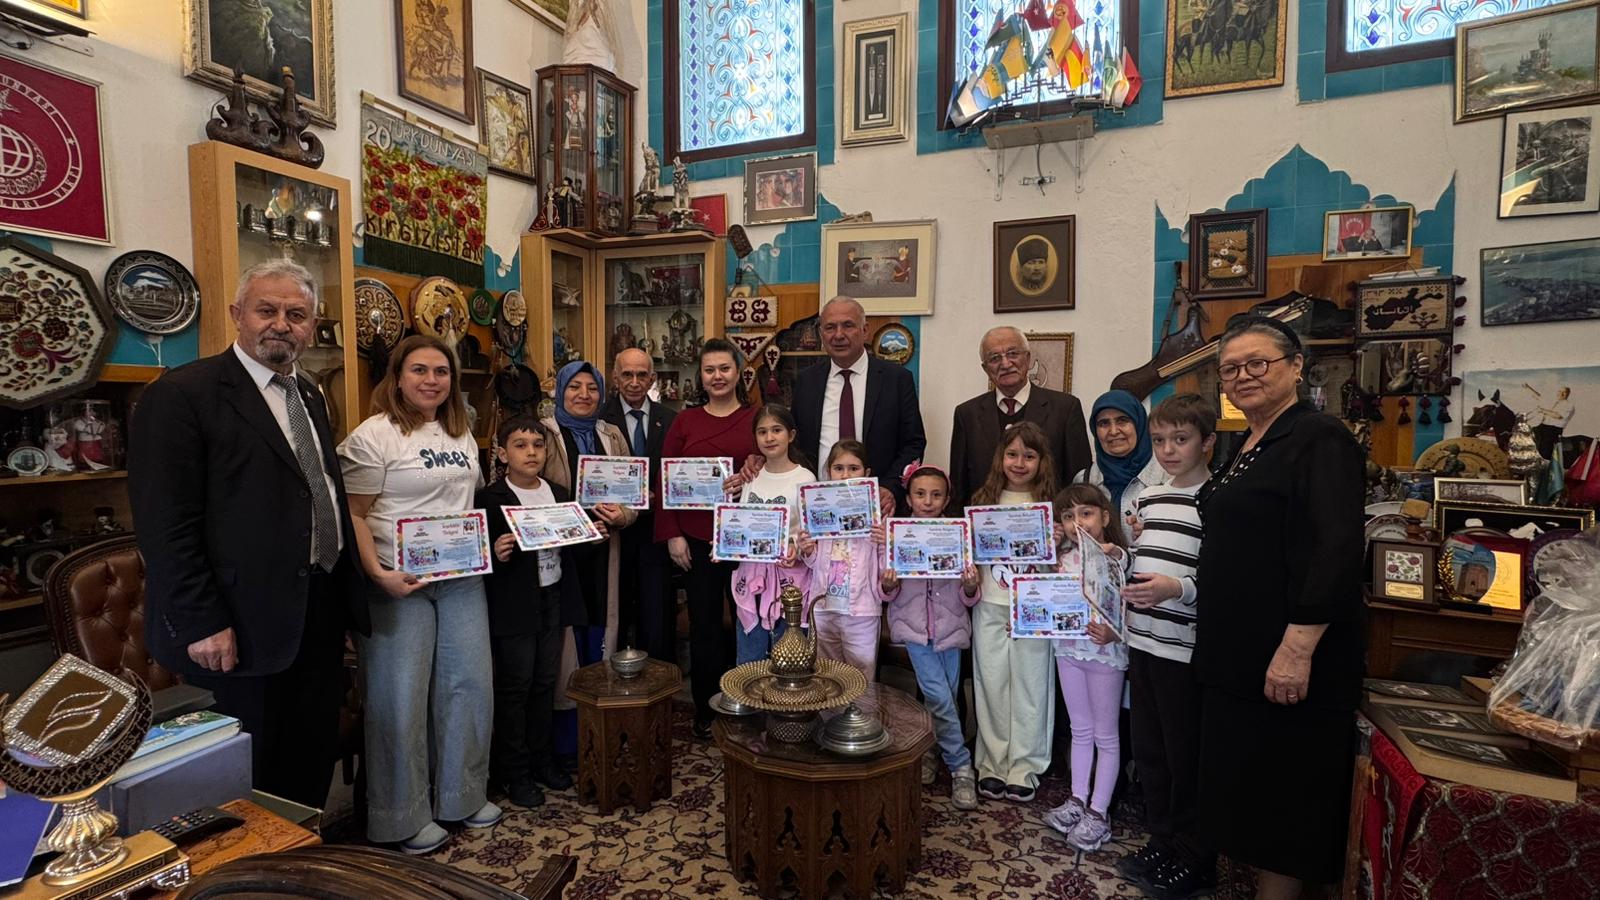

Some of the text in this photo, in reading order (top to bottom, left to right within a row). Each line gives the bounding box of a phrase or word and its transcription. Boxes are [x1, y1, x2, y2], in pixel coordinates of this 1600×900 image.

[366, 120, 393, 150] 20
[0, 199, 40, 209] LARI
[546, 562, 556, 570] day
